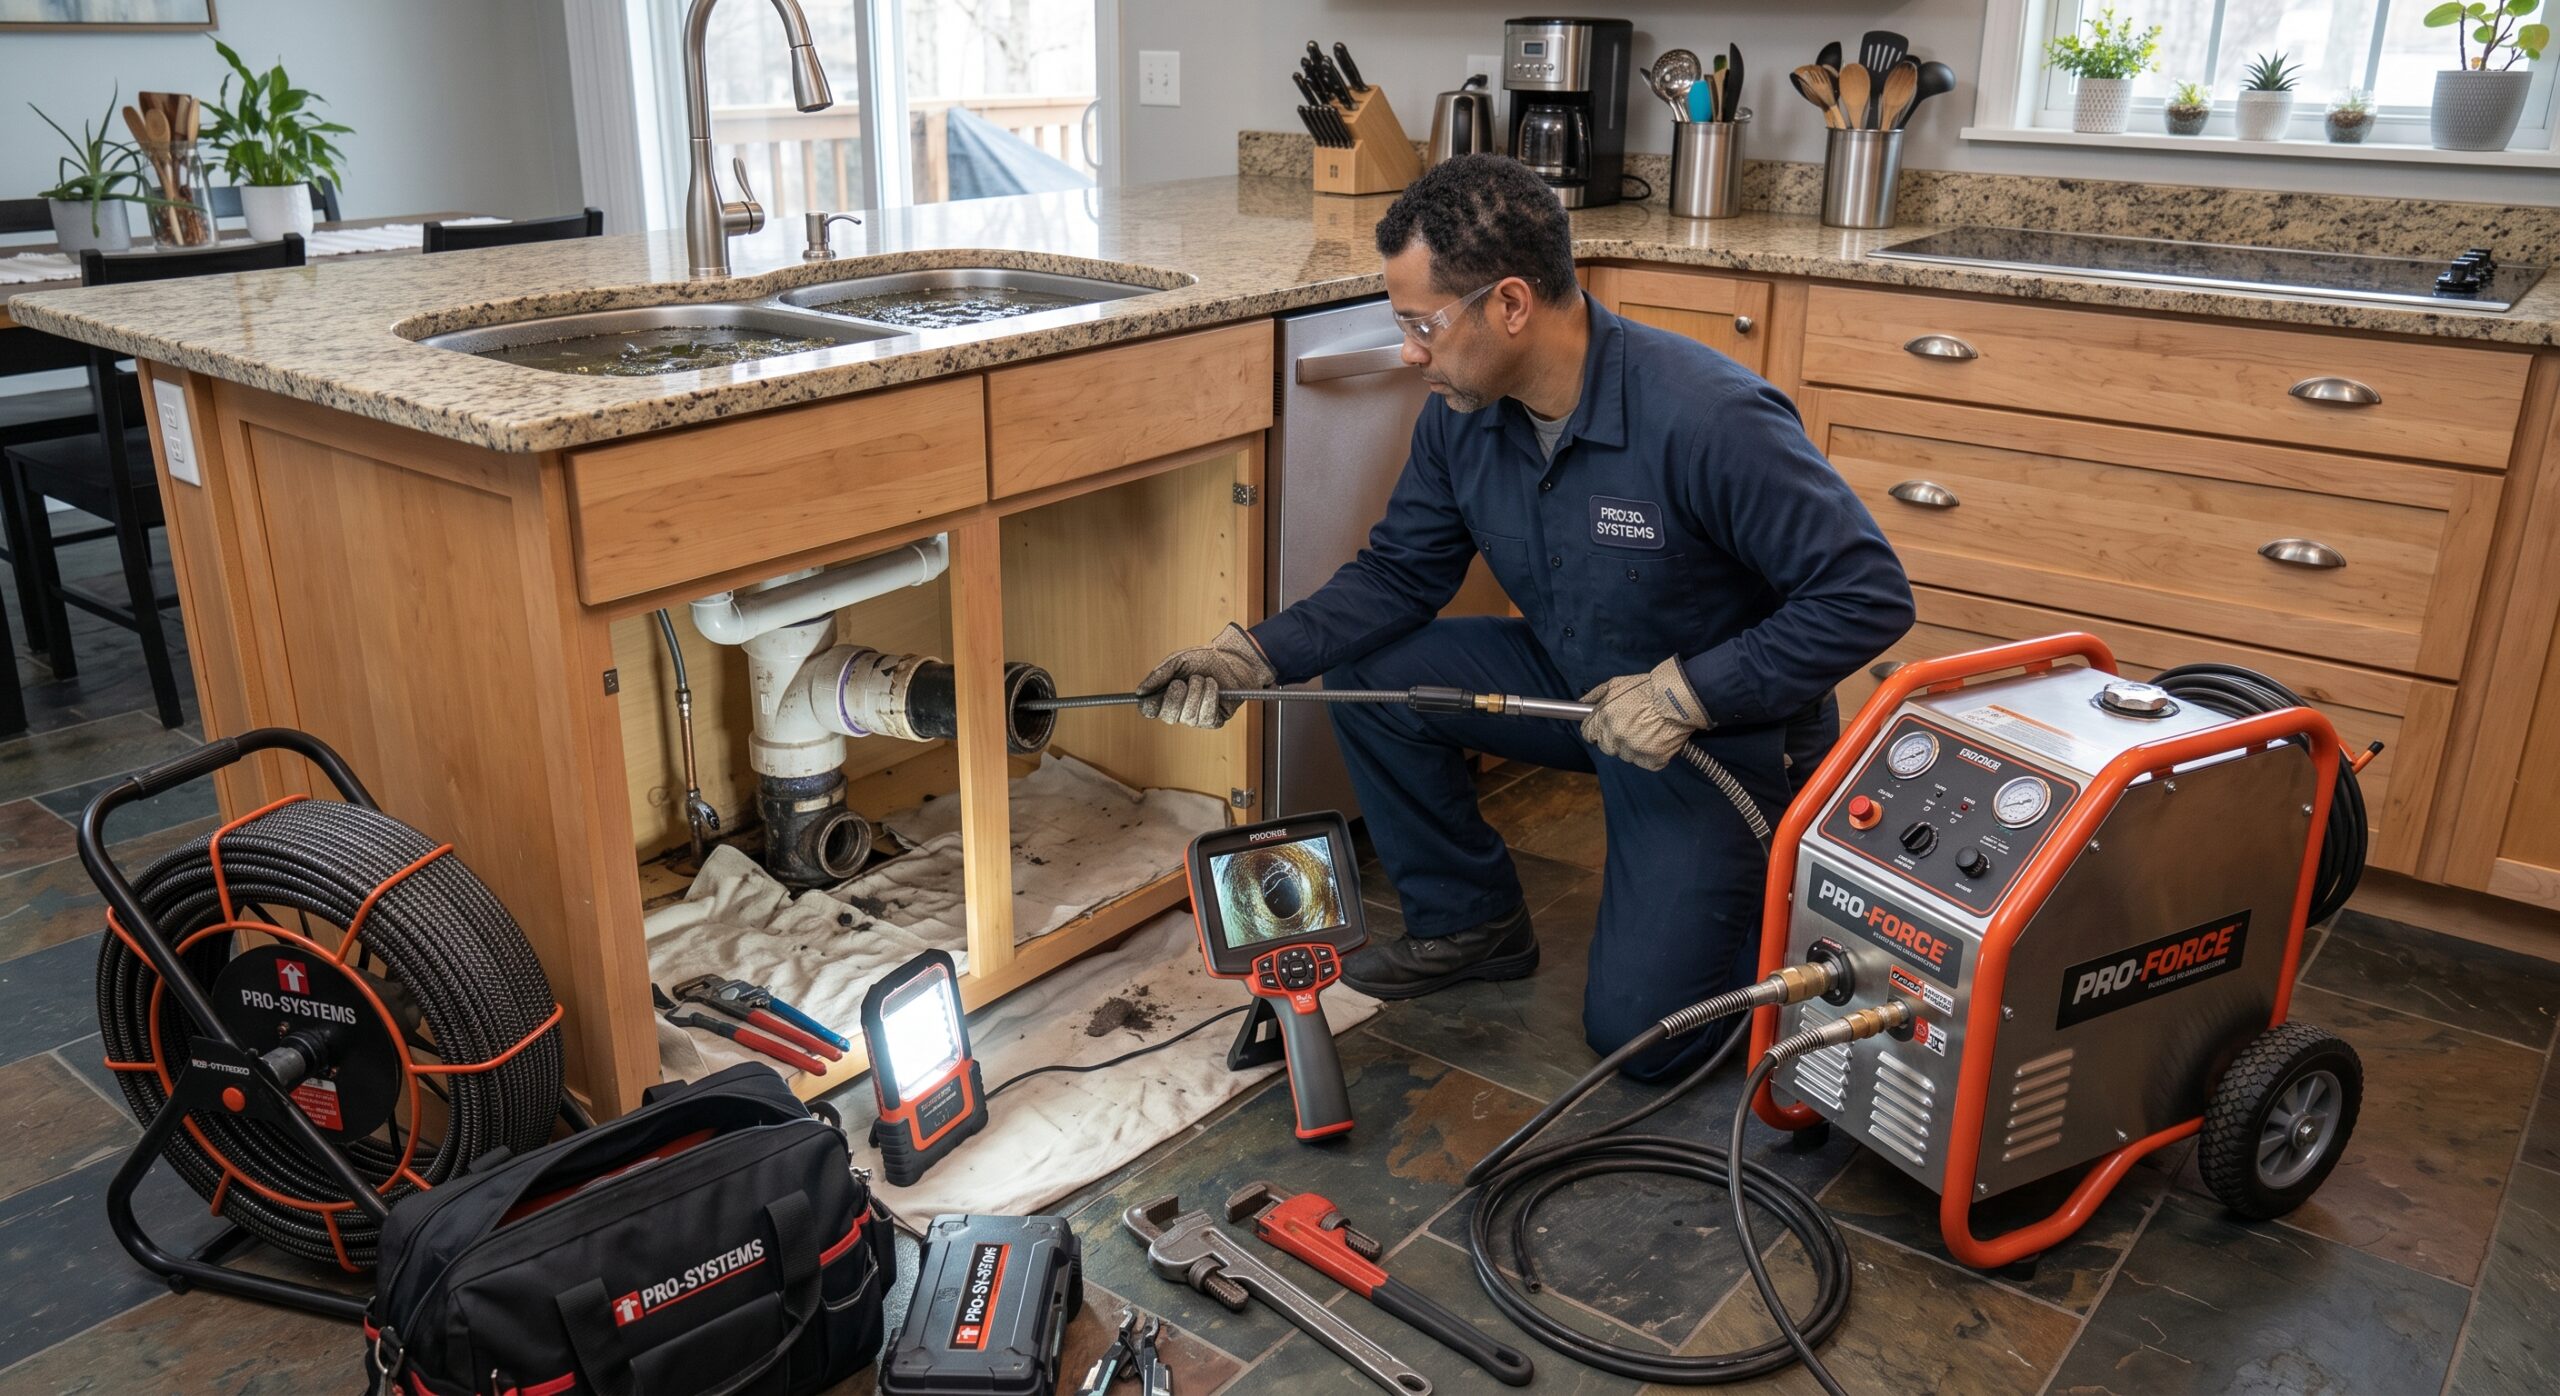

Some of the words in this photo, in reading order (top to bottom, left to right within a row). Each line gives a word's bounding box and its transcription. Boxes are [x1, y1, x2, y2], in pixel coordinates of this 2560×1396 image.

[1597, 522, 1654, 539] SYSTEMS
[1818, 879, 1947, 964] PRO-FORCE
[2072, 925, 2235, 1005] PRO-FORCE
[241, 989, 357, 1025] PRO-SYSTEMS
[642, 1238, 764, 1309] PRO-SYSTEMS
